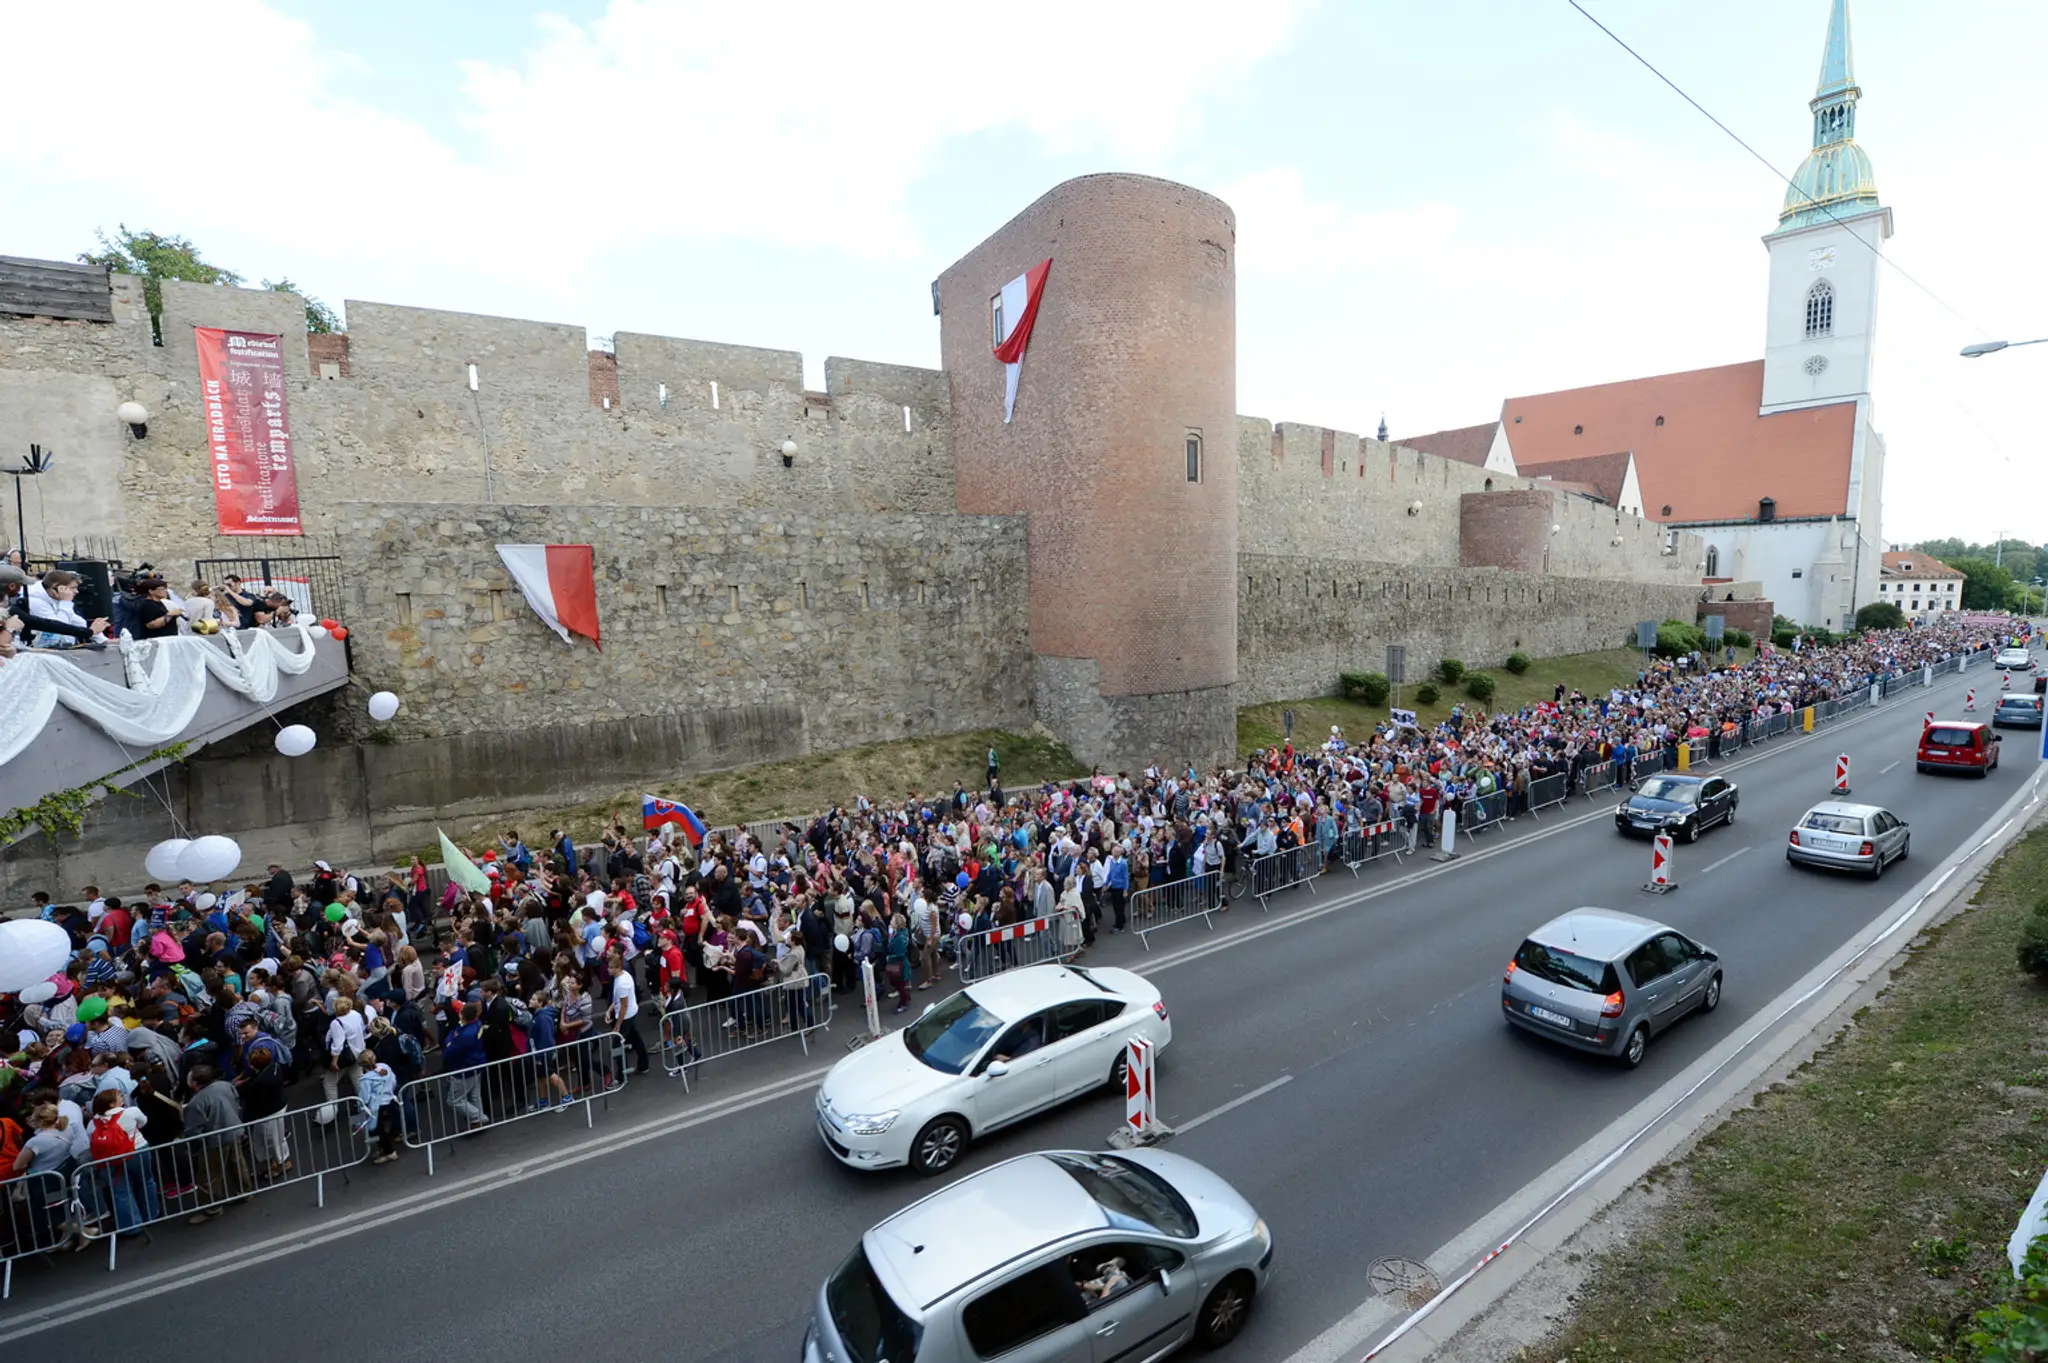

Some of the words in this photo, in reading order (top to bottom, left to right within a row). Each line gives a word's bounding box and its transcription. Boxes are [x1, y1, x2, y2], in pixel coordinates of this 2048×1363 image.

[206, 380, 226, 442] HRADBÁCH
[262, 391, 289, 471] remparts
[214, 445, 228, 460] NA
[217, 464, 232, 490] LETO
